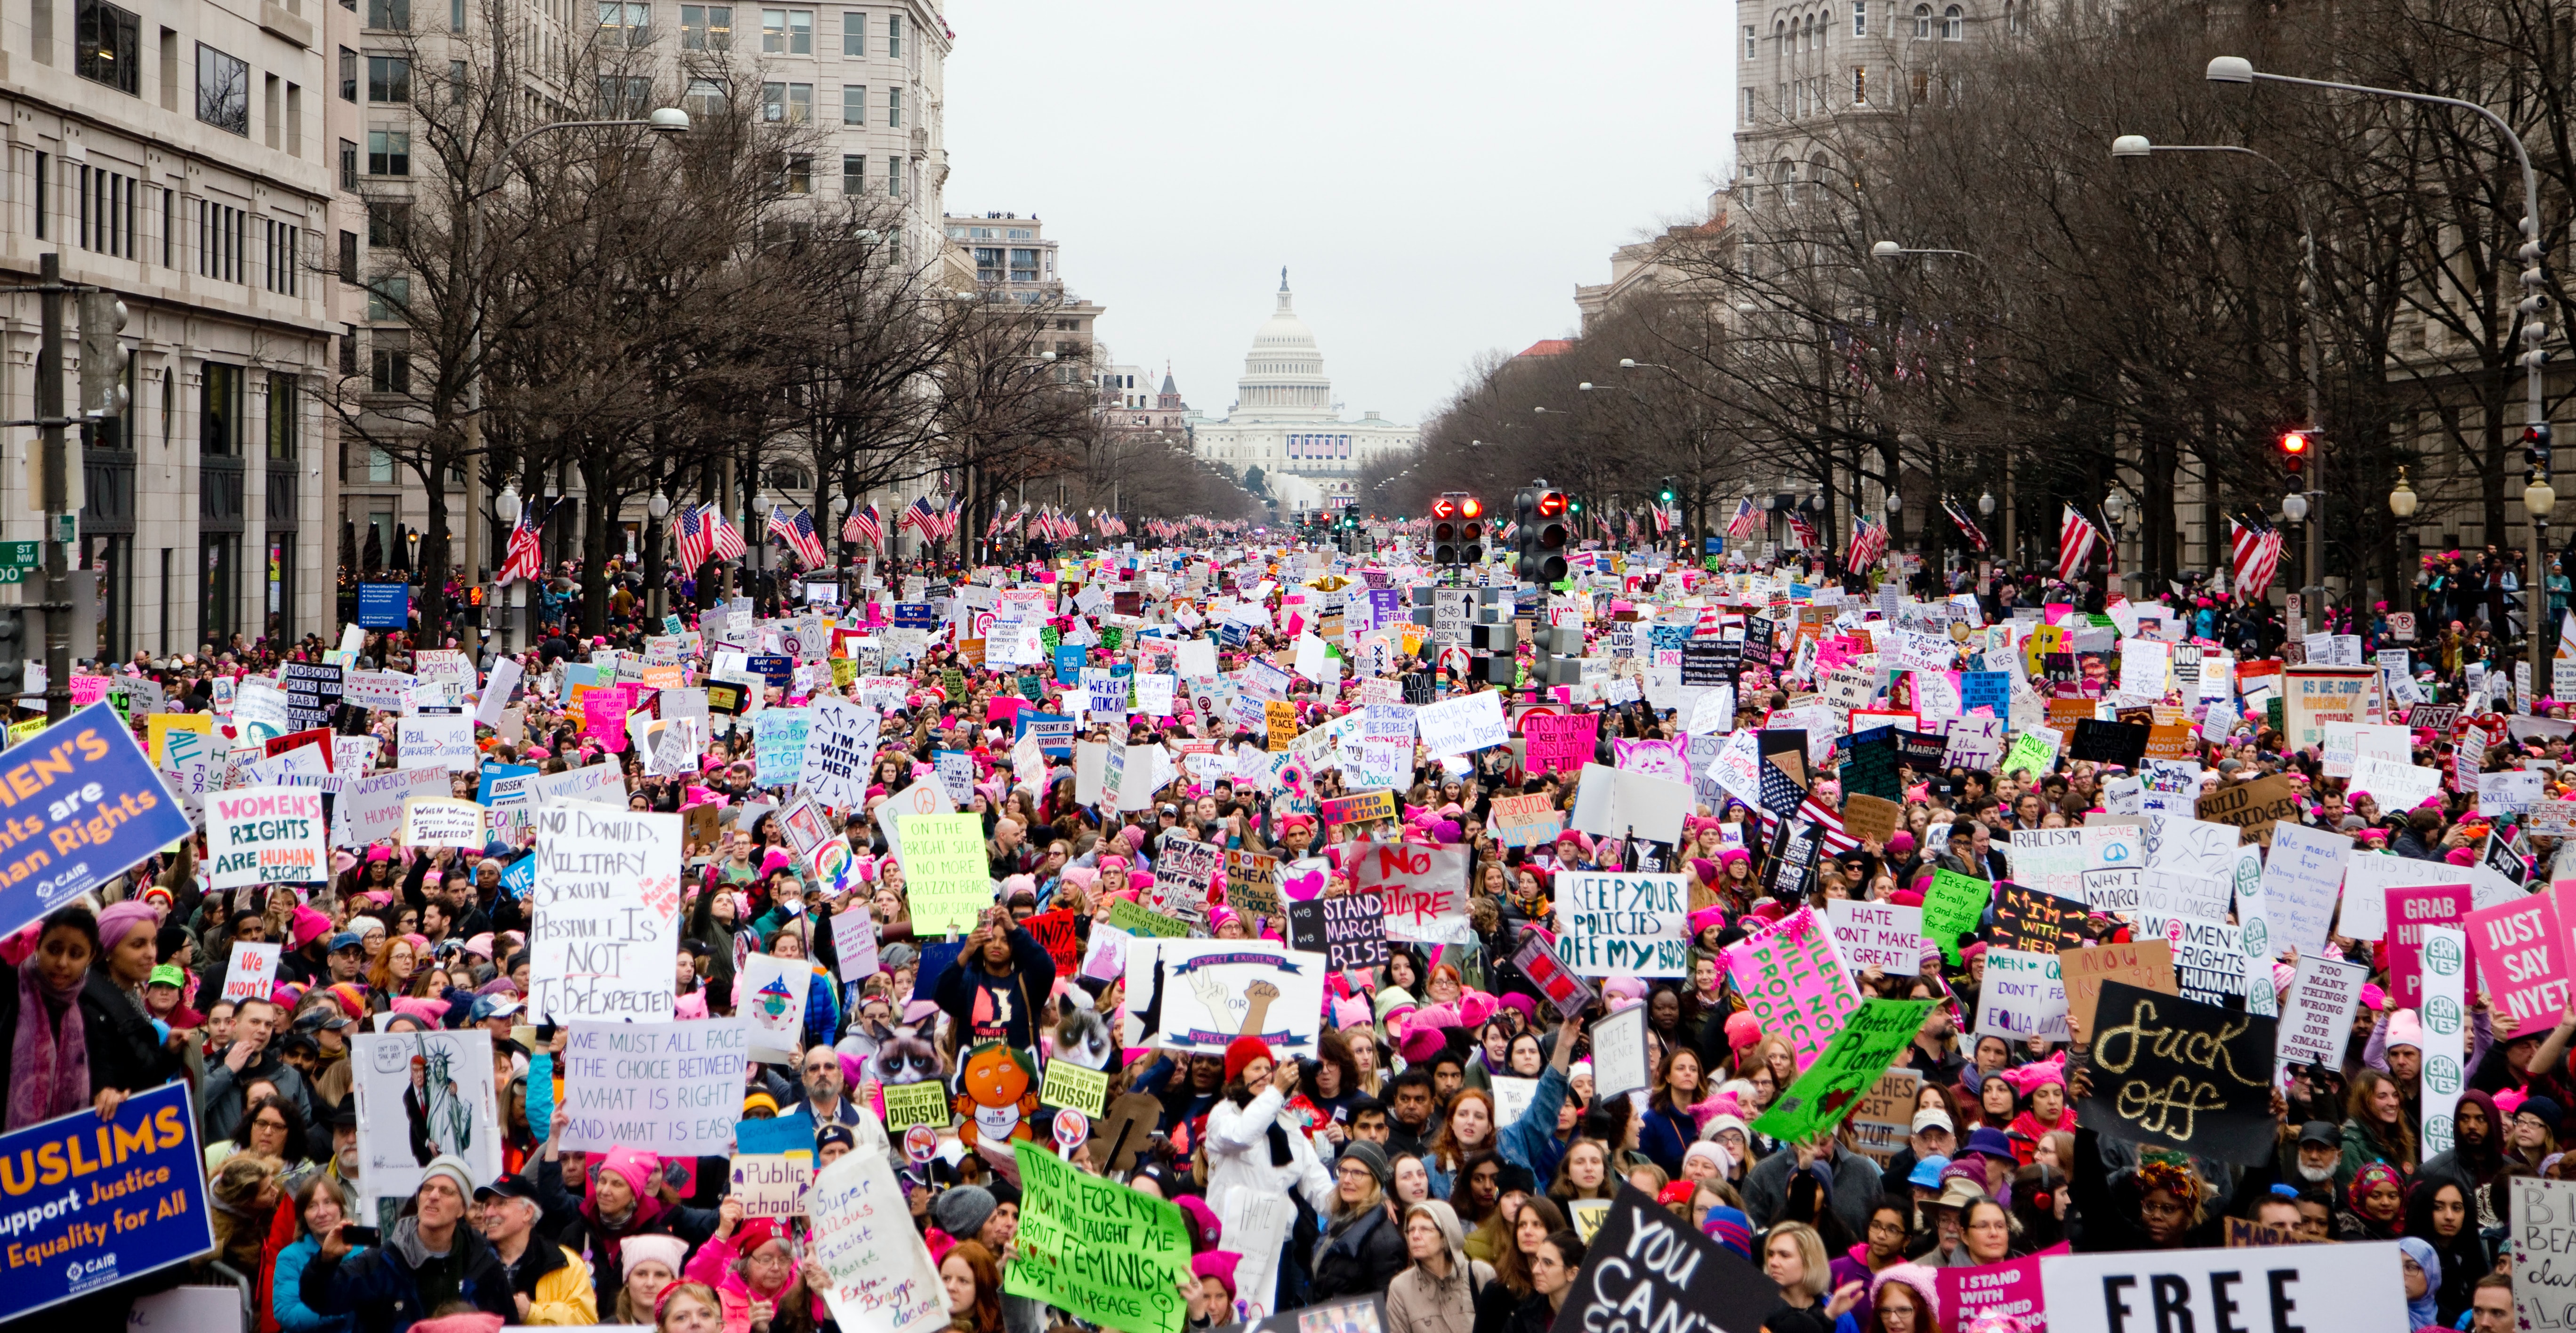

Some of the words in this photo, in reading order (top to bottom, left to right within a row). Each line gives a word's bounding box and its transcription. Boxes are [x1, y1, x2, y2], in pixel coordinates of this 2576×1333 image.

[16, 545, 32, 554] ST
[16, 554, 33, 563] NW
[1437, 592, 1457, 600] THRU
[1436, 621, 1458, 630] OBEY
[1612, 622, 1633, 632] BLACK
[1749, 616, 1762, 627] this
[1753, 626, 1769, 636] NOT
[1612, 635, 1633, 646] LIVES
[1745, 640, 1770, 653] OVARY
[419, 651, 454, 662] NASTY
[1612, 649, 1634, 658] MATTER
[1743, 648, 1769, 661] ACTION
[288, 666, 339, 678] NOBODY
[419, 663, 458, 674] WOMEN
[288, 680, 317, 691] PUTS
[322, 683, 341, 693] MY
[2303, 681, 2315, 693] AS
[2320, 681, 2335, 693] WE
[2338, 682, 2363, 694] COME
[288, 694, 318, 706] BABY
[366, 695, 391, 705] DIVIDES
[288, 710, 327, 721] MAKER
[1527, 717, 1549, 731] IT'S
[1554, 717, 1570, 731] MY
[1572, 716, 1596, 729] BODY
[405, 731, 428, 744] REAL
[449, 731, 467, 742] 140
[831, 732, 854, 749] I'M
[1539, 733, 1555, 741] KEEP
[1558, 731, 1576, 741] YOUR
[399, 746, 435, 758] CHARACTER
[441, 746, 474, 756] CHARACTERS
[821, 744, 859, 766] WITH
[1526, 741, 1589, 756] LEGISLATION
[822, 760, 851, 779] HER
[218, 796, 320, 819] WOMEN'S
[2198, 788, 2249, 817] BUILD
[2221, 799, 2296, 827] BRIDGES
[230, 821, 308, 845] RIGHTS
[540, 812, 566, 835] NO,
[577, 816, 658, 843] DONALD,
[911, 823, 928, 835] ON
[933, 823, 962, 835] THE
[538, 839, 644, 875] MILITARY
[904, 842, 945, 856] BRIGHT
[954, 843, 979, 854] SIDE
[216, 854, 256, 874] ARE
[260, 849, 315, 866] HUMAN
[916, 862, 935, 875] NO
[942, 861, 976, 874] MORE
[260, 867, 311, 881] RIGHTS
[536, 879, 620, 907] SEXUAL
[910, 880, 957, 895] GRIZZLY
[961, 881, 989, 894] BEARS
[1572, 887, 1626, 912] KEEP
[1632, 881, 1682, 915] YOUR
[914, 903, 925, 915] IN
[929, 903, 950, 916] OUR
[1324, 895, 1381, 921] STAND
[2405, 897, 2456, 920] GRAB
[1575, 910, 1661, 936] POLICIES
[1852, 908, 1892, 926] HATE
[534, 913, 614, 942] ASSAULT
[1325, 920, 1385, 941] MARCH
[2487, 908, 2544, 951] JUST
[839, 936, 853, 947] NOW
[847, 943, 857, 952] GET
[1877, 931, 1919, 948] MAKE
[566, 945, 628, 977] NOT
[841, 944, 874, 964] FORMATION
[1331, 940, 1390, 966] RISE
[1560, 939, 1599, 965] OFF
[1607, 940, 1654, 971] MY
[1658, 940, 1686, 970] BODY
[1853, 948, 1908, 968] GREAT!
[242, 952, 261, 971] We
[1191, 956, 1230, 968] RESPECT
[1234, 955, 1284, 966] EXISTENCE
[2509, 947, 2551, 983] SAY
[2319, 965, 2342, 976] TOO
[228, 981, 267, 996] won't
[2309, 975, 2349, 990] MANY
[2302, 987, 2349, 1004] THINGS
[2506, 979, 2570, 1019] NYET
[1229, 998, 1247, 1010] OR
[2300, 999, 2343, 1015] WRONG
[2306, 1012, 2330, 1025] FOR
[1190, 1033, 1229, 1044] EXPECT
[2303, 1025, 2329, 1037] ONE
[571, 1031, 599, 1049] WE
[610, 1035, 658, 1053] MUST
[665, 1033, 696, 1052] ALL
[707, 1030, 745, 1048] FACE
[2291, 1035, 2334, 1051] SMALL
[571, 1058, 606, 1077] THE
[617, 1061, 670, 1079] CHOICE
[679, 1054, 744, 1078] BETWEEN
[578, 1088, 636, 1110] WHAT
[650, 1089, 669, 1109] IS
[678, 1083, 732, 1108] RIGHT
[888, 1096, 912, 1108] HANDS
[914, 1094, 928, 1105] OFF
[931, 1092, 942, 1103] MY
[890, 1104, 945, 1127] PUSSY!
[566, 1120, 604, 1139] AND
[609, 1122, 657, 1141] WHAT
[669, 1122, 687, 1140] IS
[696, 1119, 737, 1140] EASY
[747, 1164, 804, 1183] Public
[87, 1166, 170, 1206] Justice
[1017, 1146, 1061, 1189] THIS
[1067, 1174, 1076, 1203] IS
[1082, 1184, 1122, 1218] FOR
[1126, 1193, 1158, 1226] MY
[1025, 1181, 1055, 1220] MOM
[1058, 1199, 1078, 1232] WHO
[1079, 1216, 1132, 1245] TAUGHT
[1143, 1228, 1175, 1253] ME
[7, 1221, 107, 1268] Equality
[113, 1207, 149, 1234] for
[157, 1189, 187, 1222] All
[1020, 1215, 1057, 1250] ABOUT
[1062, 1235, 1177, 1292] FEMINISM
[2103, 1269, 2310, 1333] FREE
